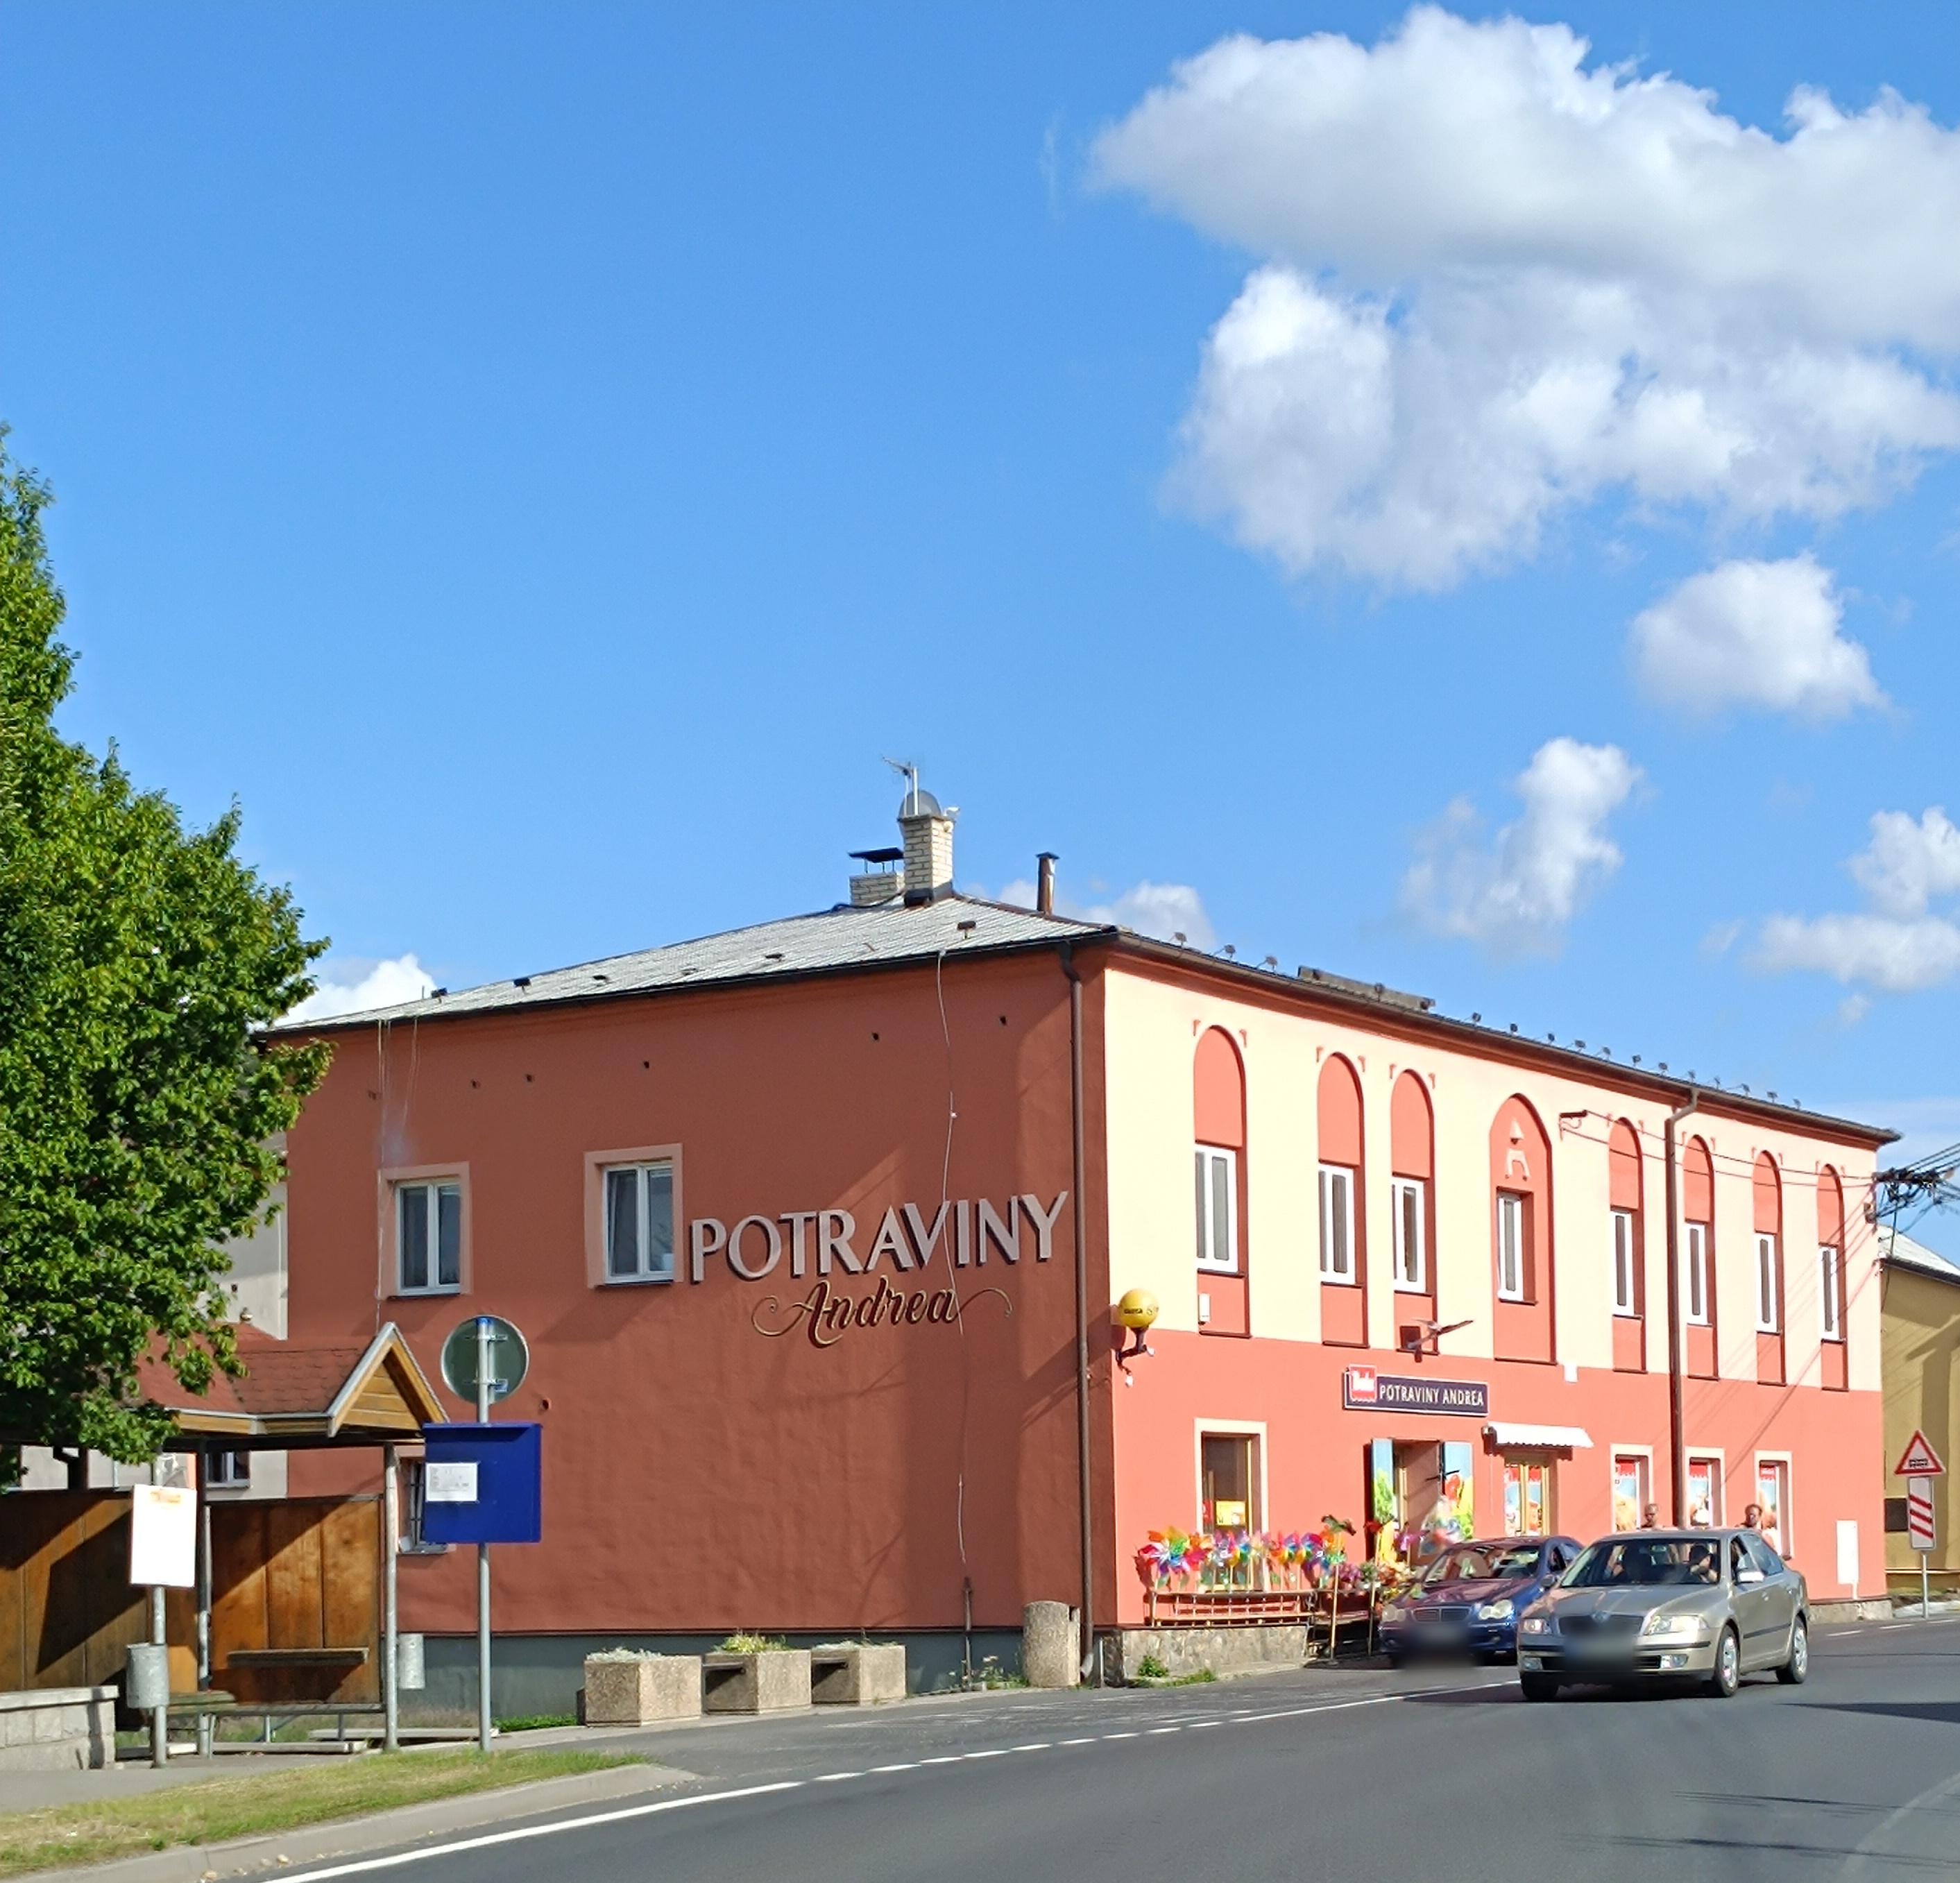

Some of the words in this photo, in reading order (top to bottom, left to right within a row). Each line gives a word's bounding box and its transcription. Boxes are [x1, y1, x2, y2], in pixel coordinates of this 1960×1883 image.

[690, 1191, 1068, 1284] POTRAVINY
[751, 1275, 1013, 1348] Andrea
[1379, 1384, 1439, 1404] POTRAVINY
[1442, 1389, 1484, 1406] ANDREA
